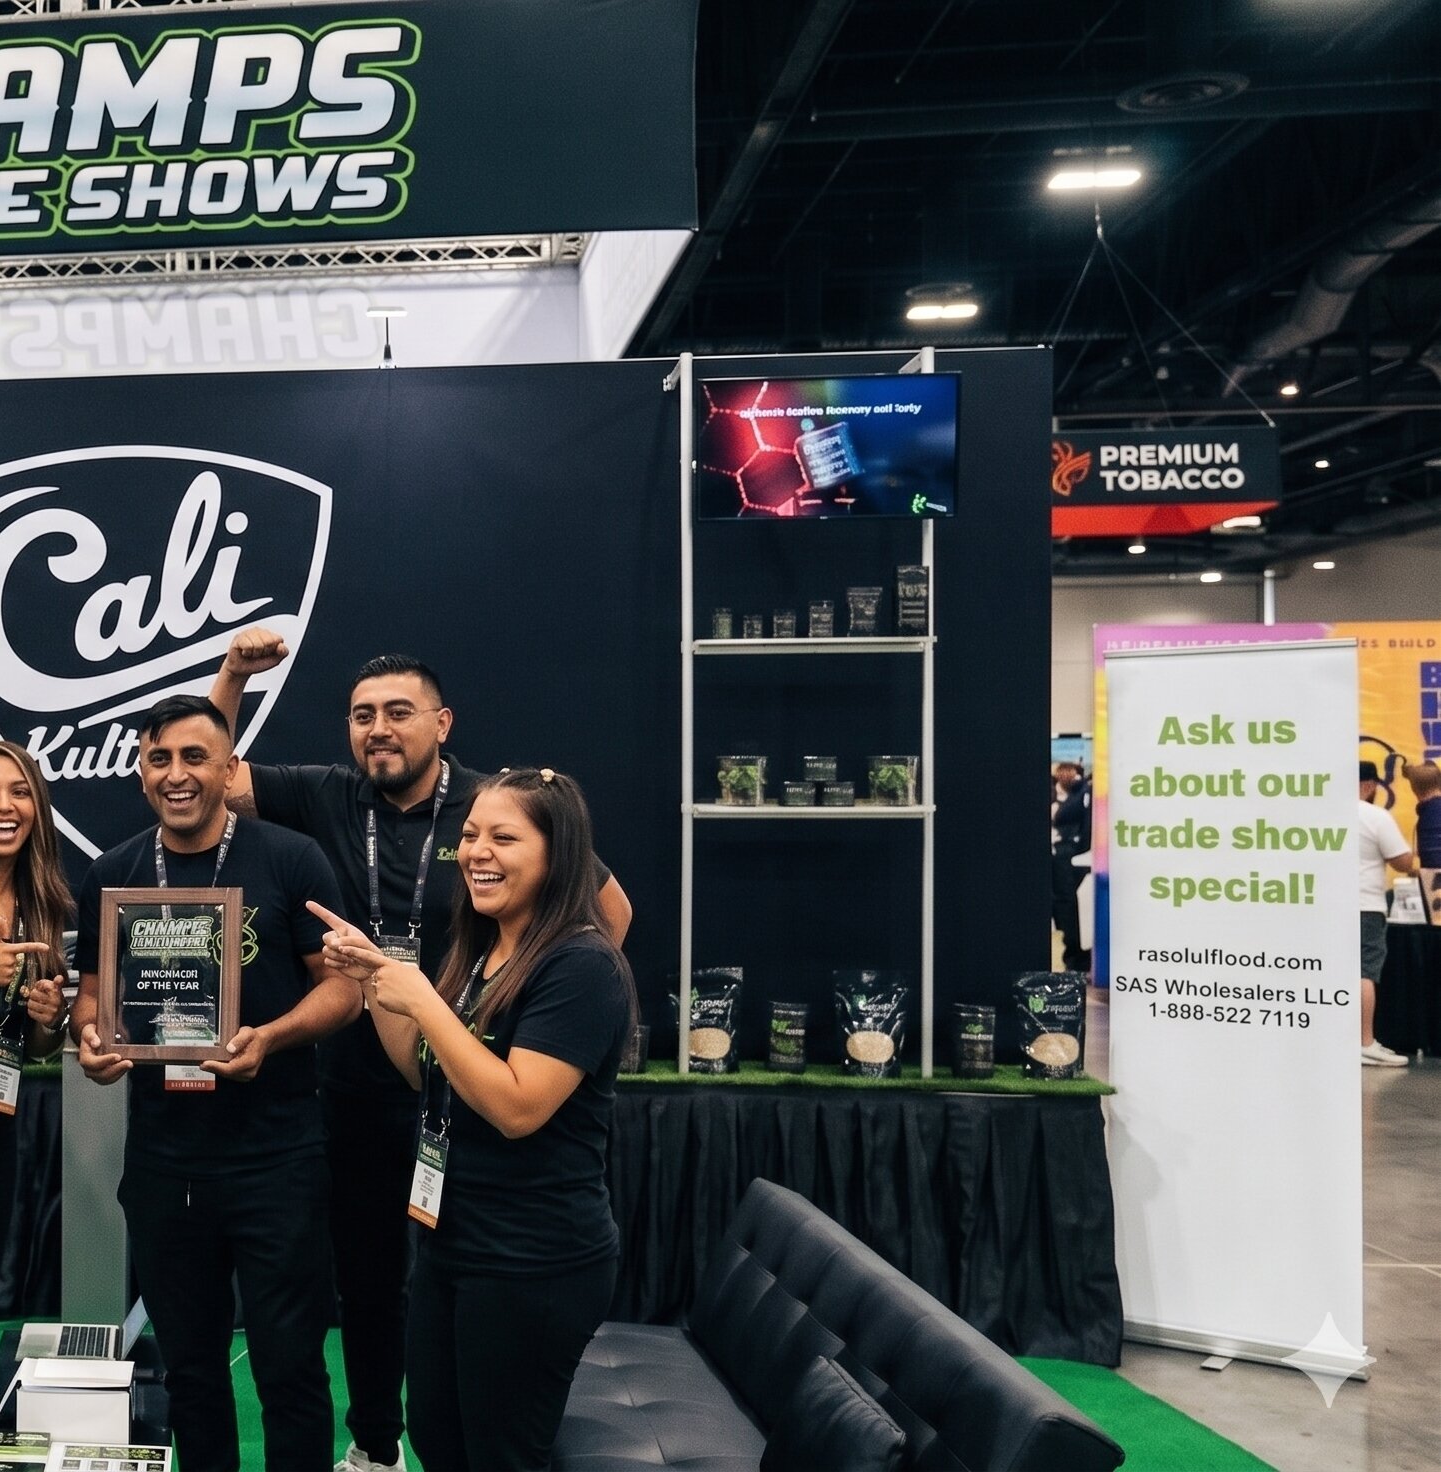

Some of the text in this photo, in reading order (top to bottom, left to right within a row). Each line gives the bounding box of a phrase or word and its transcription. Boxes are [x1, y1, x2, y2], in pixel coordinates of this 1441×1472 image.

[65, 151, 400, 223] SHOWS
[1100, 443, 1239, 467] PREMIUM
[1099, 467, 1245, 492] TOBACCO
[1157, 714, 1297, 747] Ask us
[26, 723, 142, 783] Kult
[1129, 766, 1332, 799] about our
[1114, 818, 1348, 852] trade show
[1150, 872, 1316, 908] special!
[1138, 947, 1323, 972] rasolulflood.com
[136, 981, 200, 990] OF THE YEAR
[1115, 975, 1350, 1007] SAS Wholesalers LLC
[1148, 1002, 1311, 1029] 1-888-522 7119
